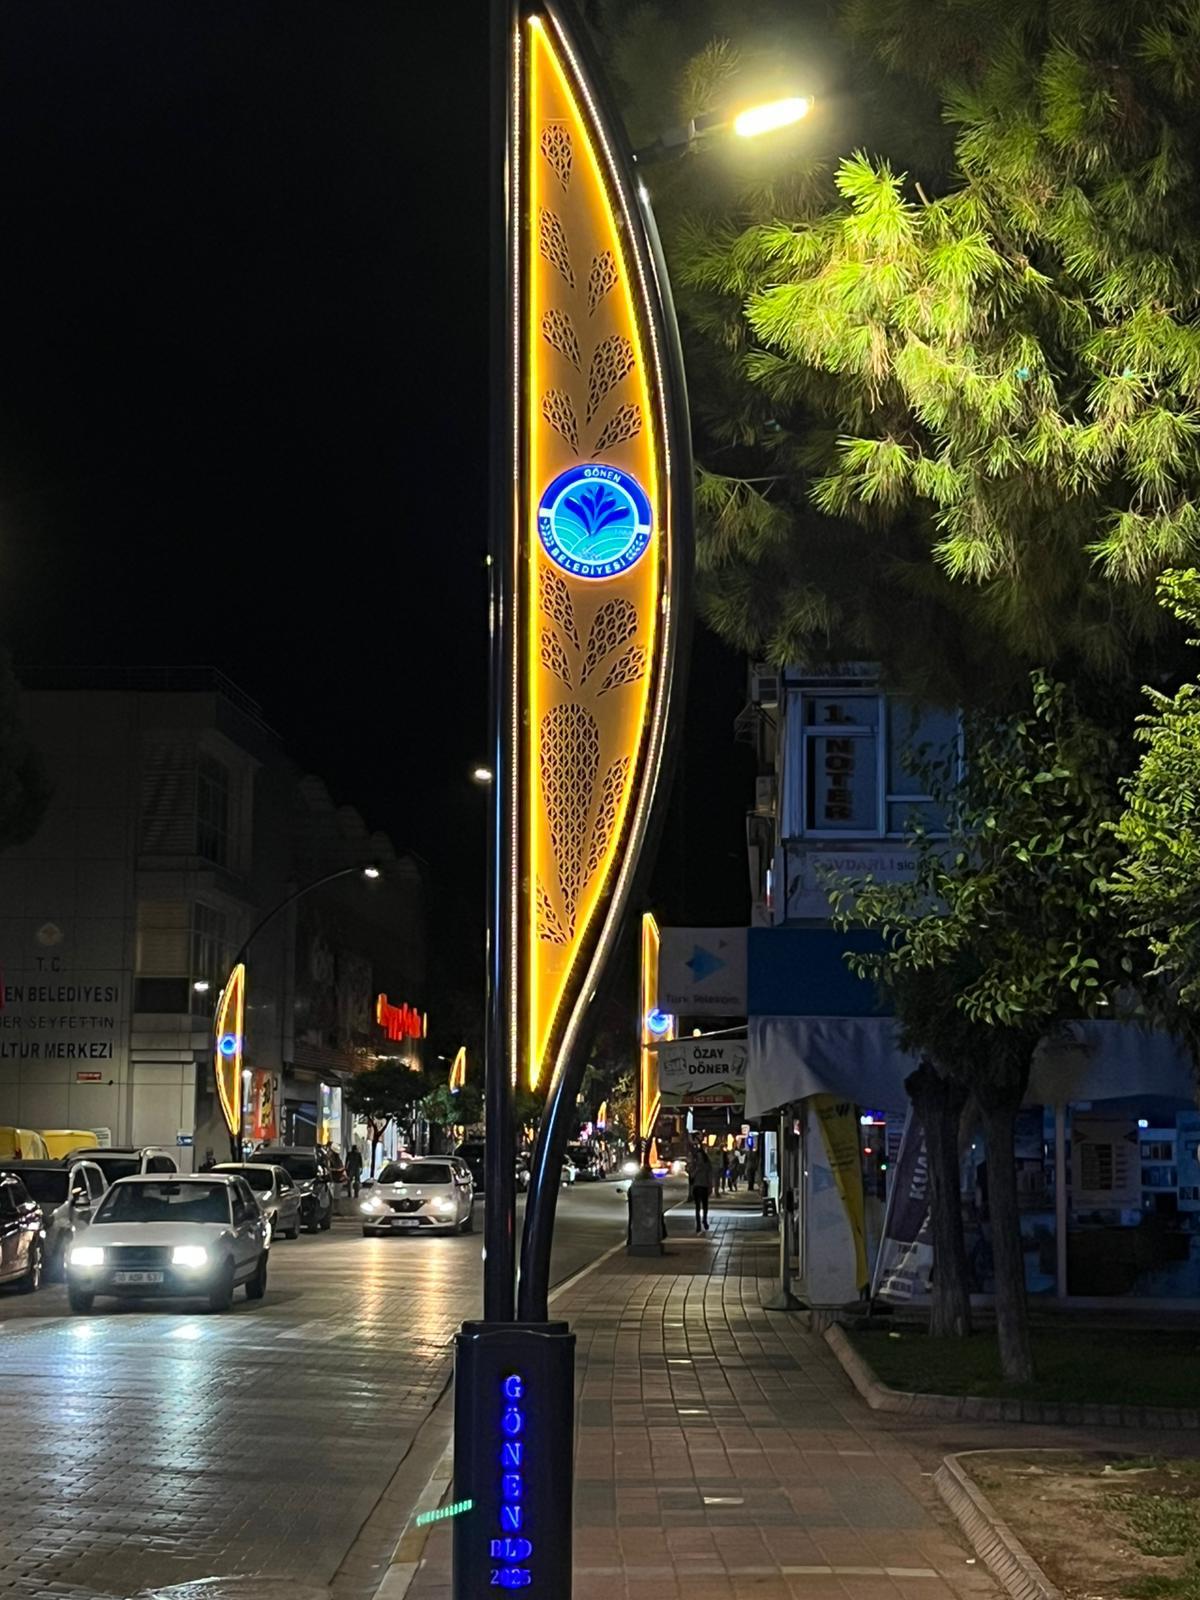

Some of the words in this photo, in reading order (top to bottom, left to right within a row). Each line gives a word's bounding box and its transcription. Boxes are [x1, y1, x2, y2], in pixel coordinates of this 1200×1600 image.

[584, 468, 621, 482] GÖNEN
[551, 548, 626, 575] BELEDİYESİ
[825, 738, 854, 819] NOTER
[693, 1045, 724, 1059] ÖZAY
[688, 1061, 730, 1075] DÖNER
[504, 1374, 522, 1529] GÖNEN
